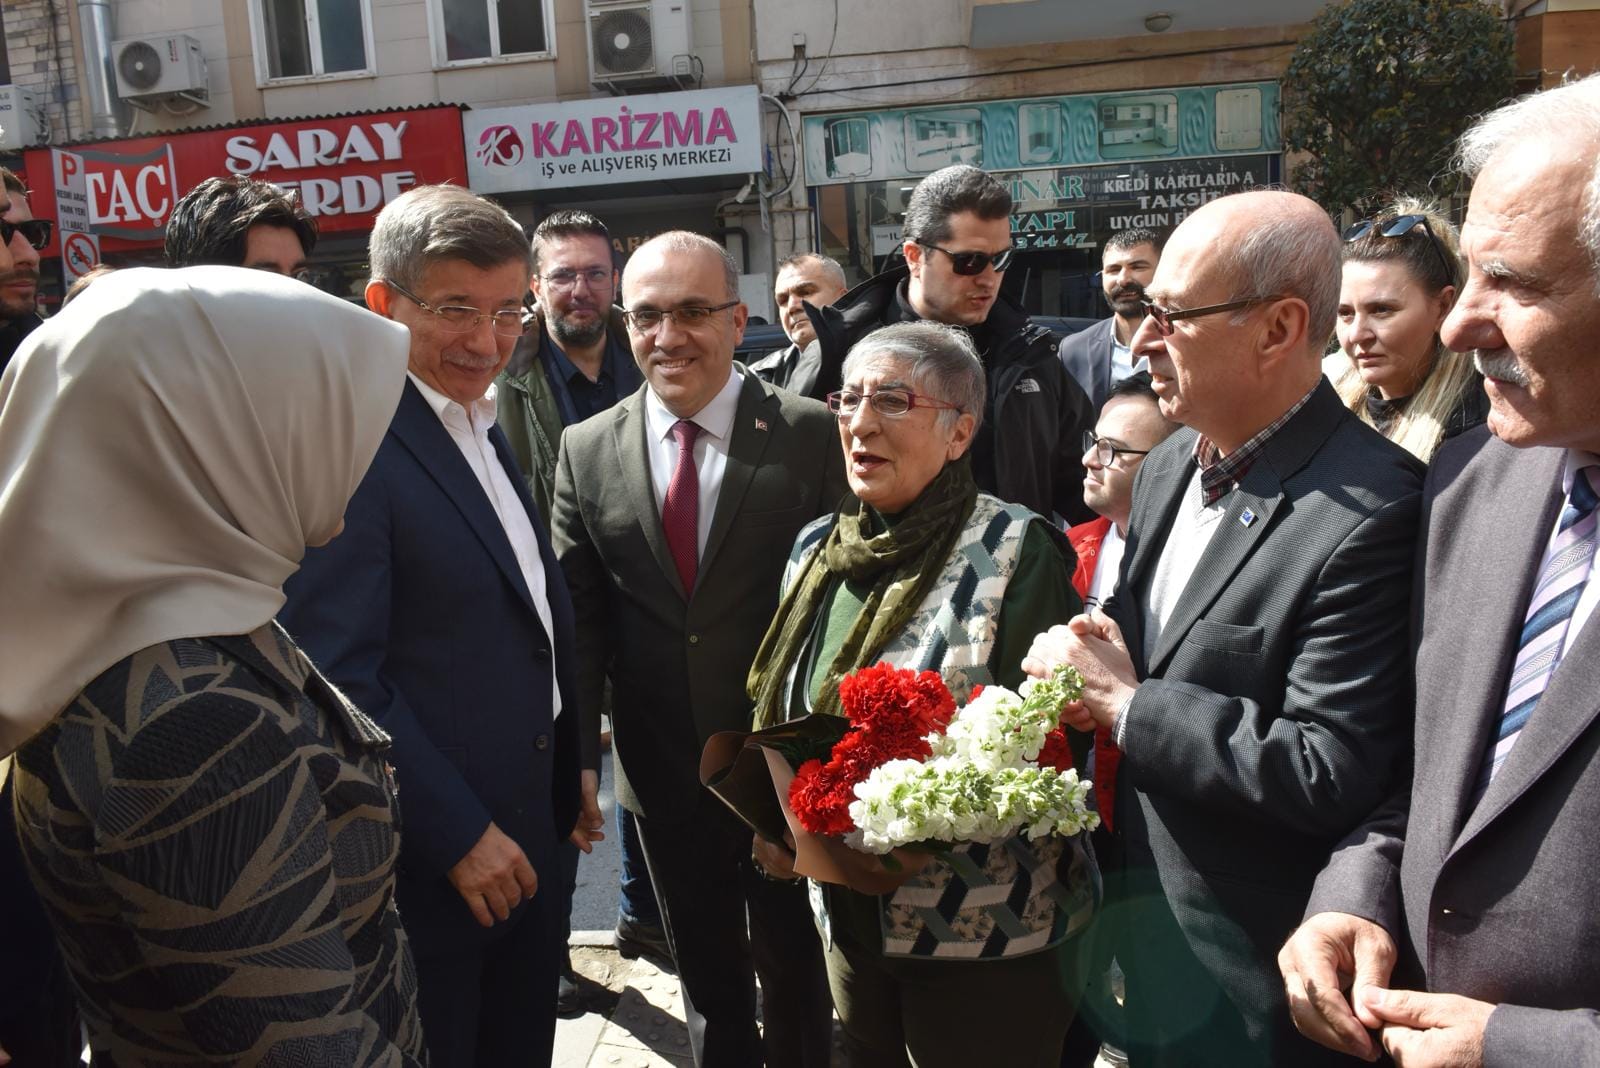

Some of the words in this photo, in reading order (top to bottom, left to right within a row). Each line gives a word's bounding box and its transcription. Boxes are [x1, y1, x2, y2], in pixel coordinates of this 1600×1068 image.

[531, 105, 738, 159] KARİZMA
[225, 120, 407, 175] SARAY
[61, 153, 78, 187] P
[559, 163, 576, 175] ve
[1103, 173, 1150, 193] KREDİ
[1010, 210, 1076, 233] YAPI
[1110, 212, 1169, 230] UYGUN
[1033, 234, 1058, 248] 44
